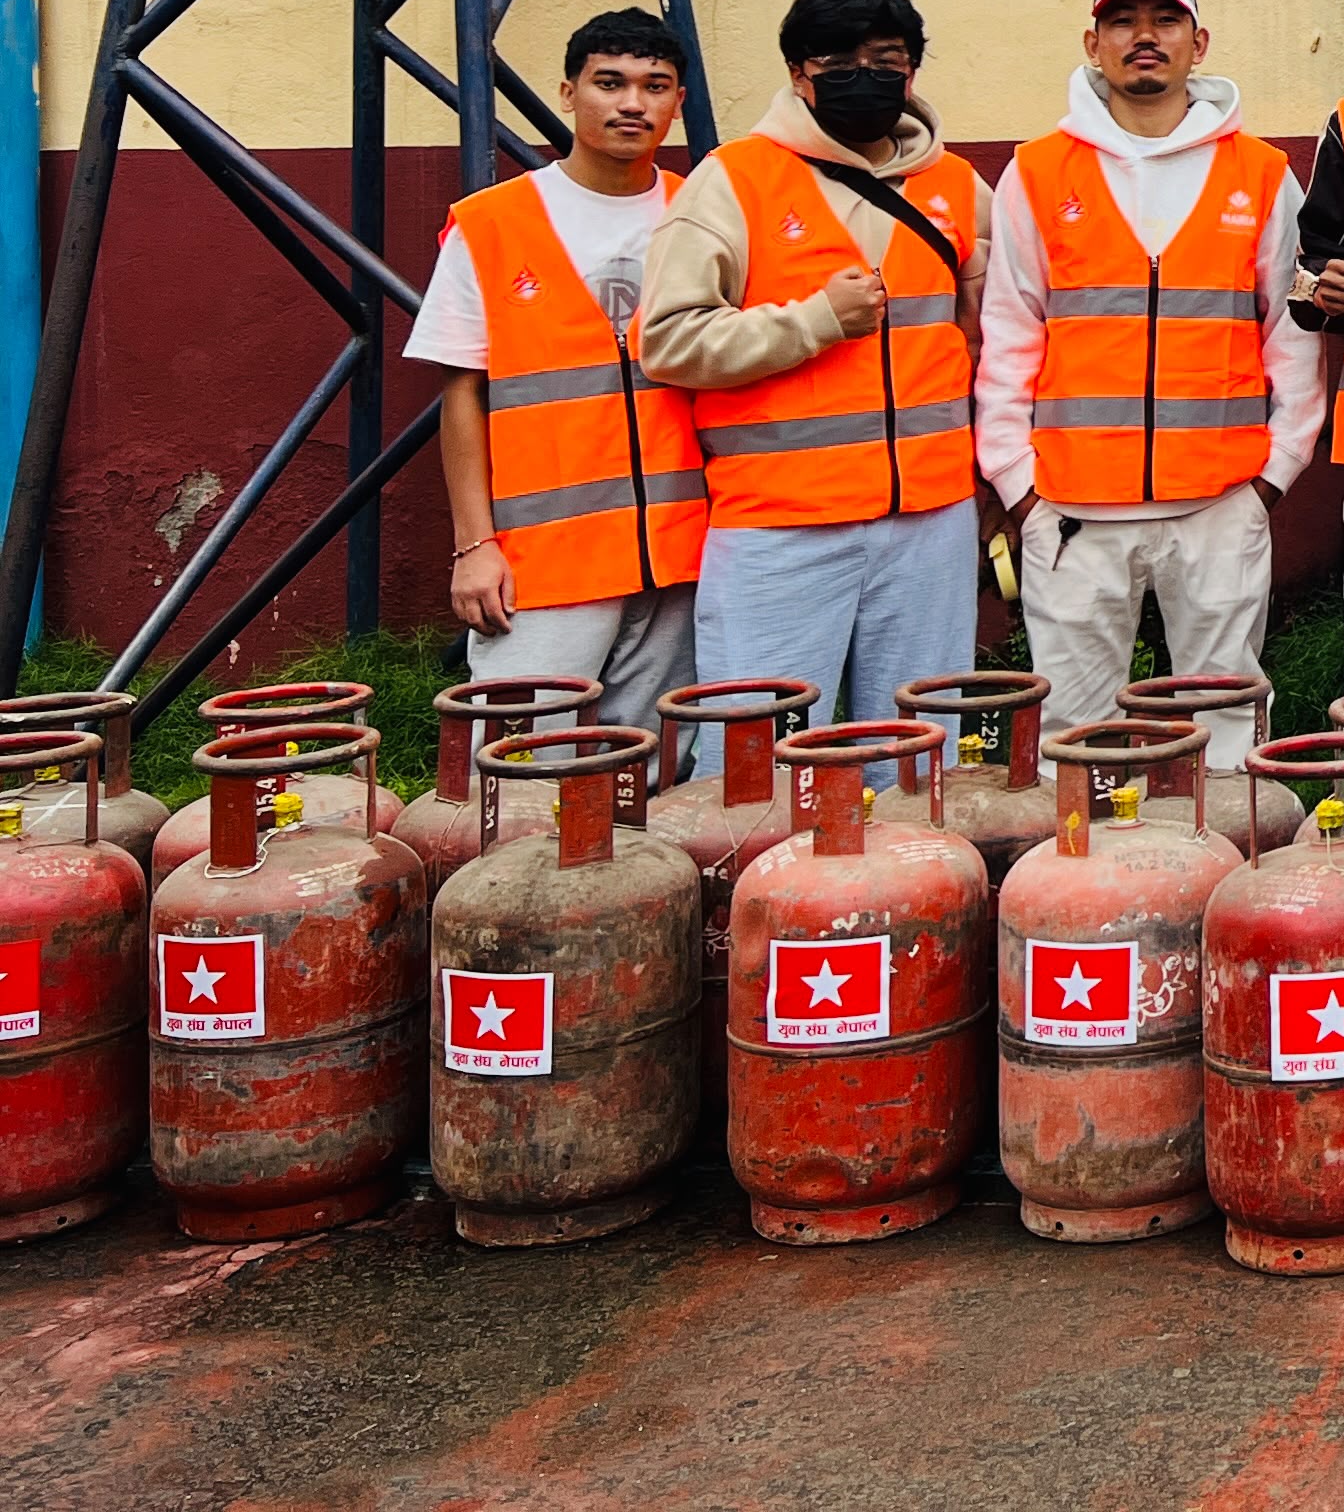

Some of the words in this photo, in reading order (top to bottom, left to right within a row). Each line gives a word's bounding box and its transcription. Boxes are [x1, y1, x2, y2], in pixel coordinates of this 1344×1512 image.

[256, 775, 276, 817] 15.4
[618, 773, 635, 809] 15.3
[166, 1017, 183, 1033] युवा
[186, 1018, 206, 1032] संघ
[212, 1016, 253, 1031] नेपाल
[777, 1024, 801, 1039] युवा
[805, 1023, 828, 1037] संघ
[836, 1019, 877, 1034] नेपाल
[1033, 1023, 1053, 1038] युवा
[1057, 1024, 1078, 1038] संघ
[1085, 1023, 1126, 1038] नेपाल
[451, 1051, 470, 1068] युवा
[472, 1053, 492, 1068] संघ
[499, 1054, 540, 1069] नेपाल
[1283, 1060, 1308, 1076] युवा
[1313, 1058, 1336, 1072] संघ
